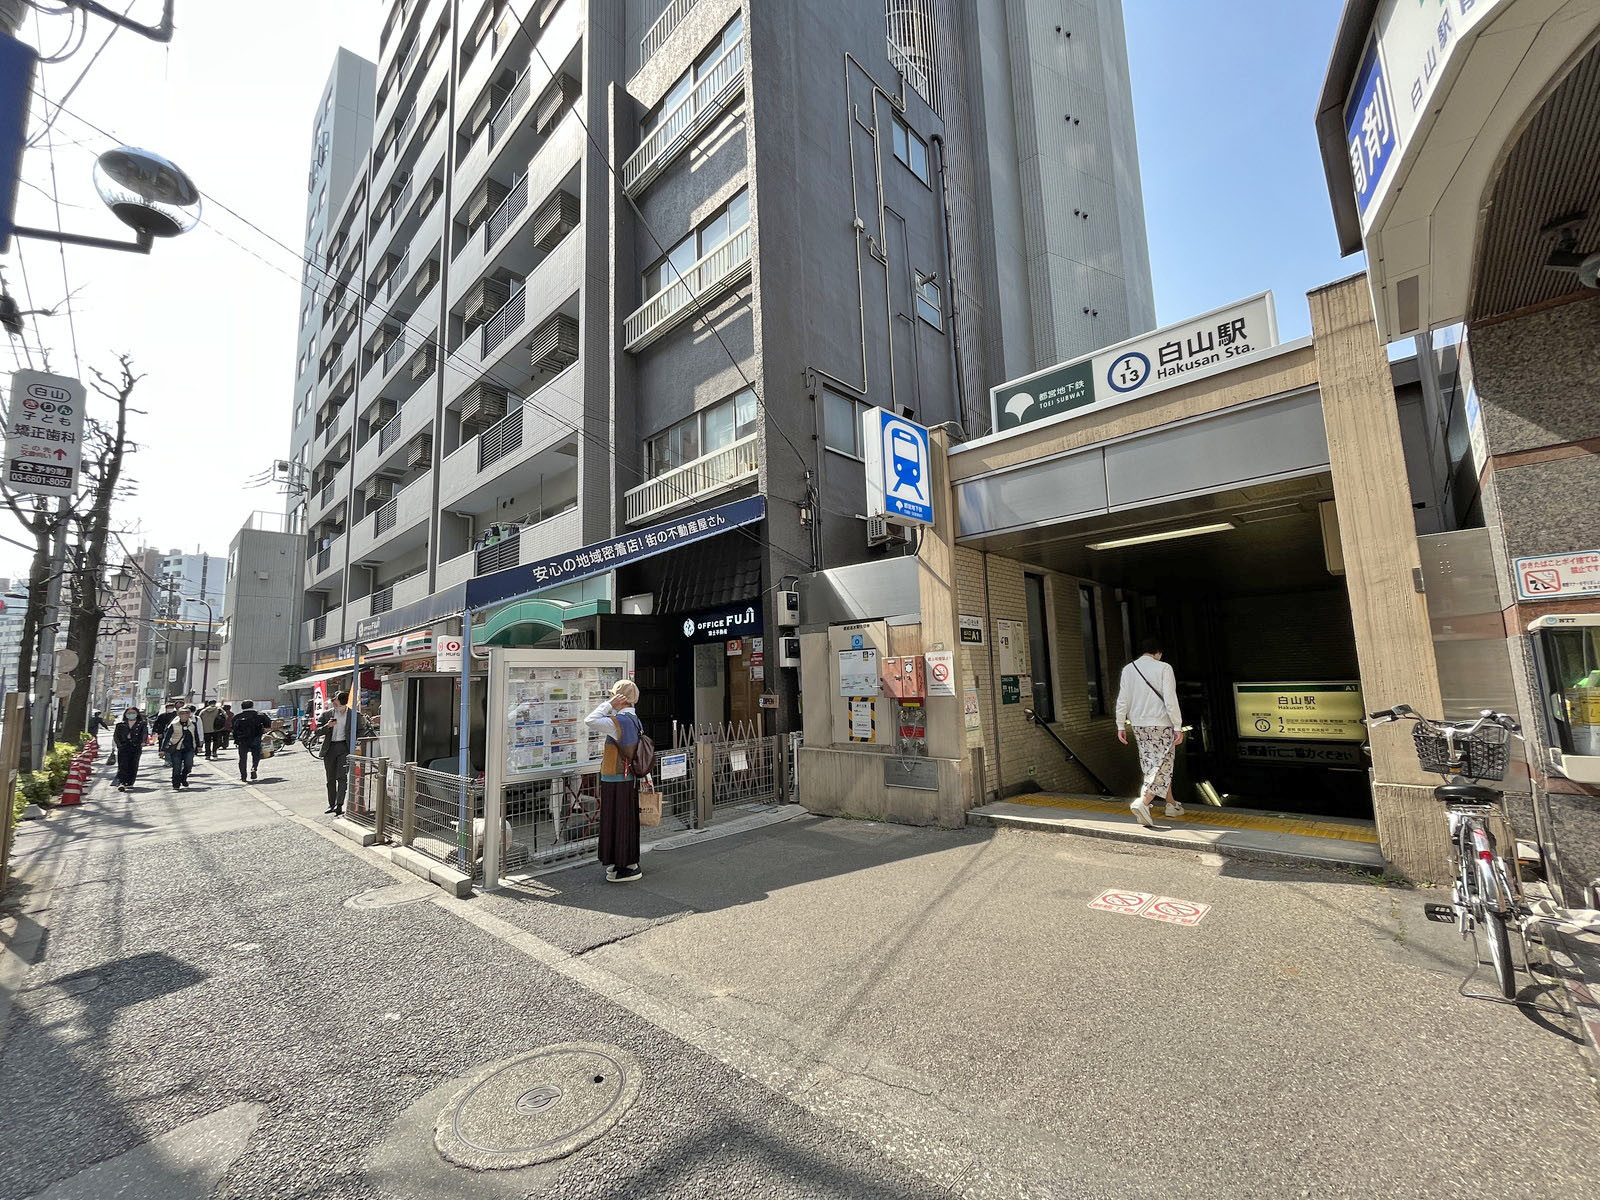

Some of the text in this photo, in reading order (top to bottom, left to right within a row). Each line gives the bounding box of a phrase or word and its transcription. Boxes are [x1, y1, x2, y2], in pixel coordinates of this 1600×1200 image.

[1411, 7, 1452, 112] 白山駅
[1158, 317, 1248, 366] 白山駅
[1124, 359, 1132, 371] I
[1157, 344, 1255, 380] Hakusan Sta.
[1120, 370, 1140, 385] 13
[34, 387, 64, 400] 白山
[1039, 380, 1085, 401] 都営地下鉄
[1039, 390, 1085, 409] TOEI SUBWAY
[23, 410, 71, 427] 子ども
[14, 423, 76, 444] 矯正歯科
[11, 473, 71, 487] 03-6801-8057
[697, 620, 724, 630] OFFICE
[1278, 696, 1316, 705] 白山駅
[1278, 716, 1283, 724] 1
[1279, 725, 1285, 733] 2
